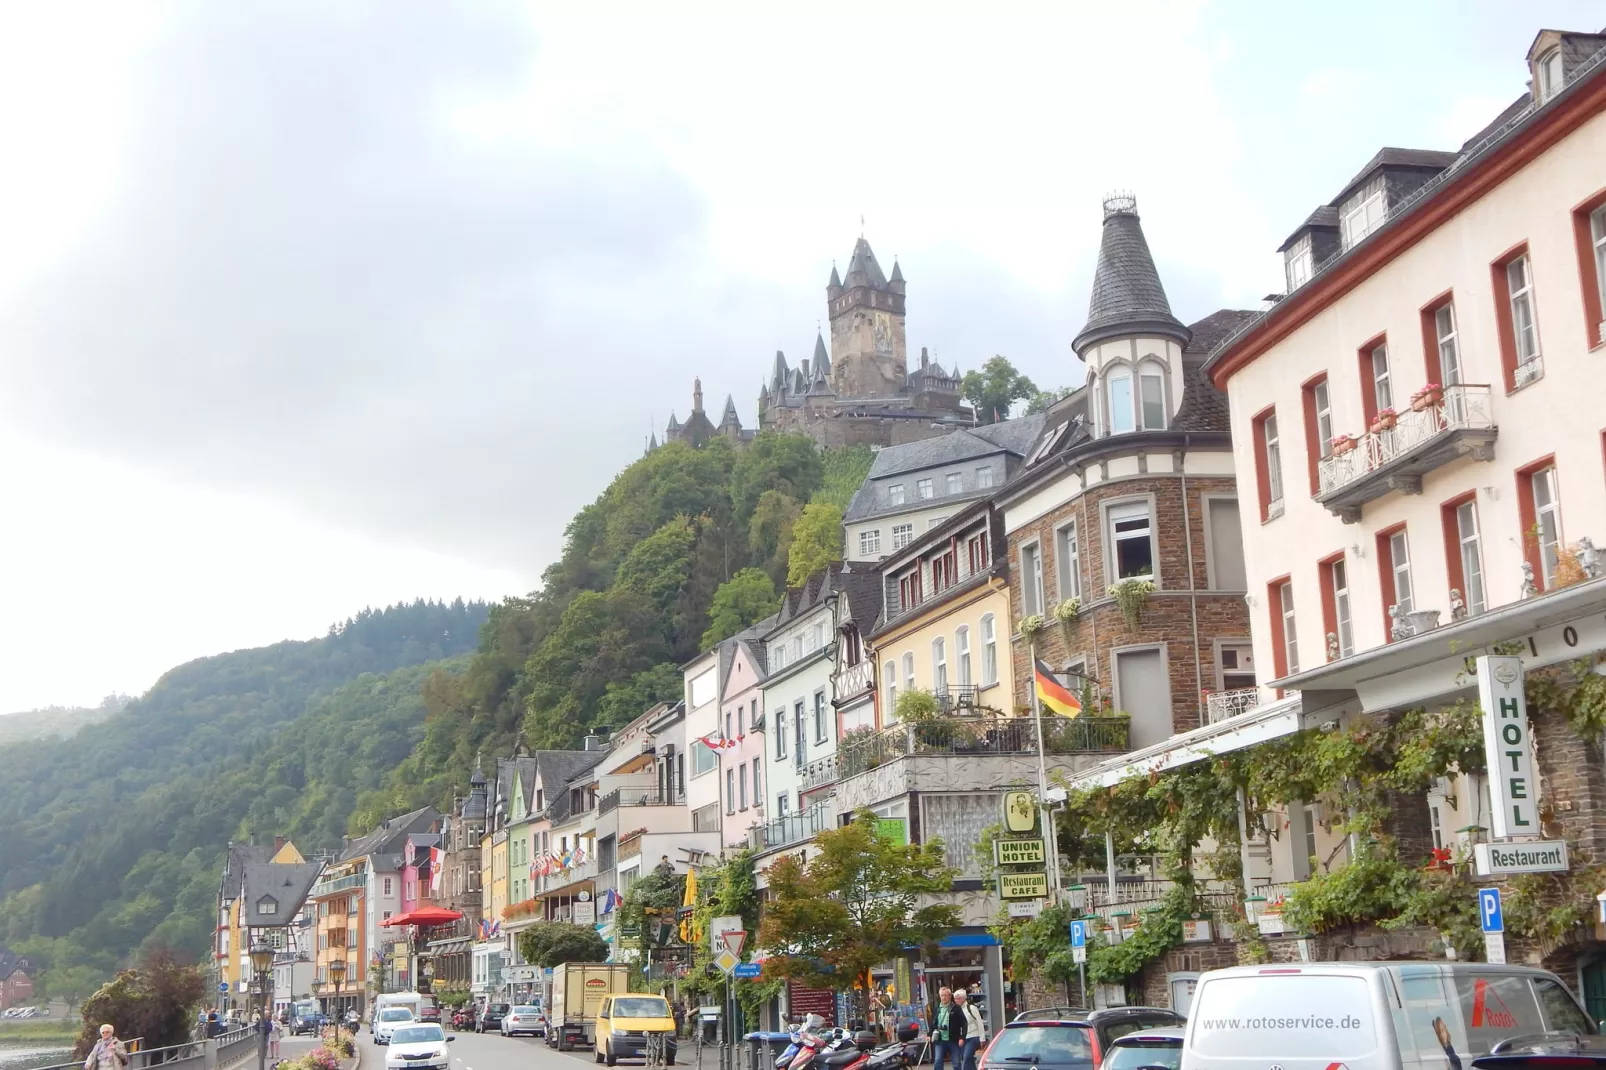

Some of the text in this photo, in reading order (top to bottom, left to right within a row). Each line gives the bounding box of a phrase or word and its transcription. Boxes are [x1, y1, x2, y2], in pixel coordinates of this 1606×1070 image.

[1499, 697, 1530, 827] HOTEL
[1002, 842, 1040, 852] UNION
[1002, 852, 1041, 862] HOTEL
[1491, 847, 1562, 867] Restaurant
[1003, 875, 1045, 887] Restaurant
[1011, 887, 1038, 895] CAFE
[1483, 894, 1496, 927] P
[1073, 924, 1081, 944] P
[1203, 1014, 1361, 1030] www.rotoservice.de
[1485, 1007, 1513, 1028] Roto
